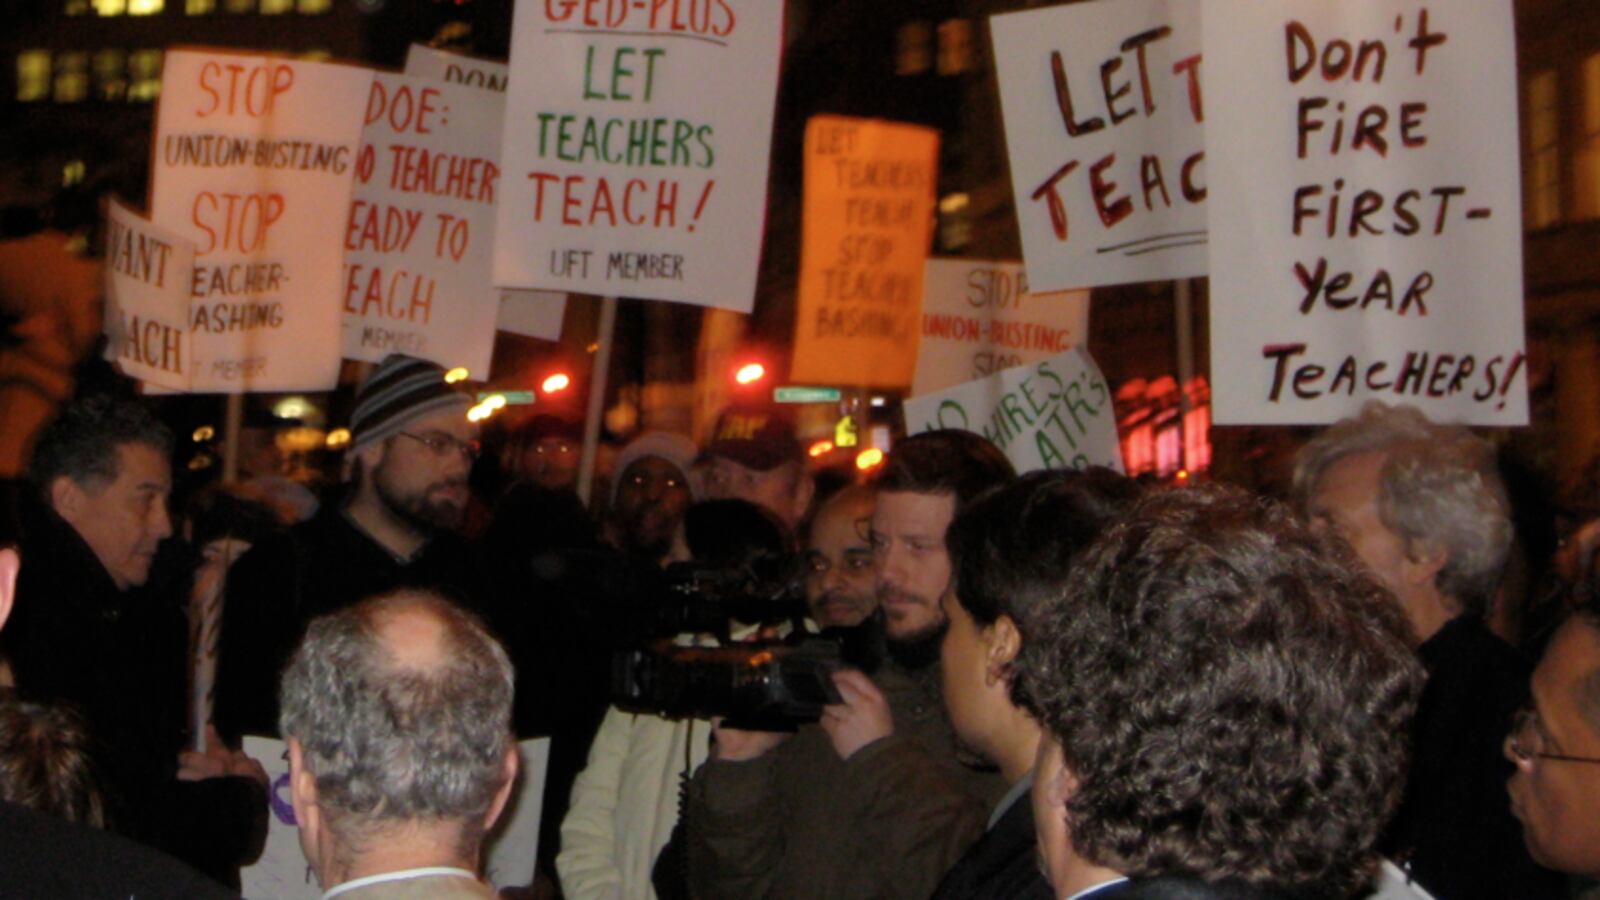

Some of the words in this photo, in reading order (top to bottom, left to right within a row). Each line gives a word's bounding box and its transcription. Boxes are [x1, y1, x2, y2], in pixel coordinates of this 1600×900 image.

[582, 46, 666, 102] LET
[1285, 8, 1447, 83] Don't
[196, 61, 294, 117] STOP
[365, 80, 450, 133] DOE:
[1051, 26, 1174, 137] LET
[165, 134, 350, 174] UNION-BUSTING
[537, 112, 715, 168] TEACHERS
[1296, 98, 1427, 158] FiRE
[356, 144, 375, 184] O
[389, 145, 501, 204] TEACHER
[527, 172, 715, 233] TEACH!
[1031, 151, 1207, 241] TEAC
[192, 191, 285, 258] STOP
[437, 213, 468, 262] TO
[342, 264, 436, 324] EACH
[550, 250, 593, 280] UFT
[606, 251, 685, 281] MEMBER
[966, 268, 1029, 308] STOP
[1294, 258, 1435, 316] YeAR
[122, 313, 182, 374] ACH
[188, 304, 283, 333] ASHING
[922, 314, 1071, 351] UNION-BUSTING
